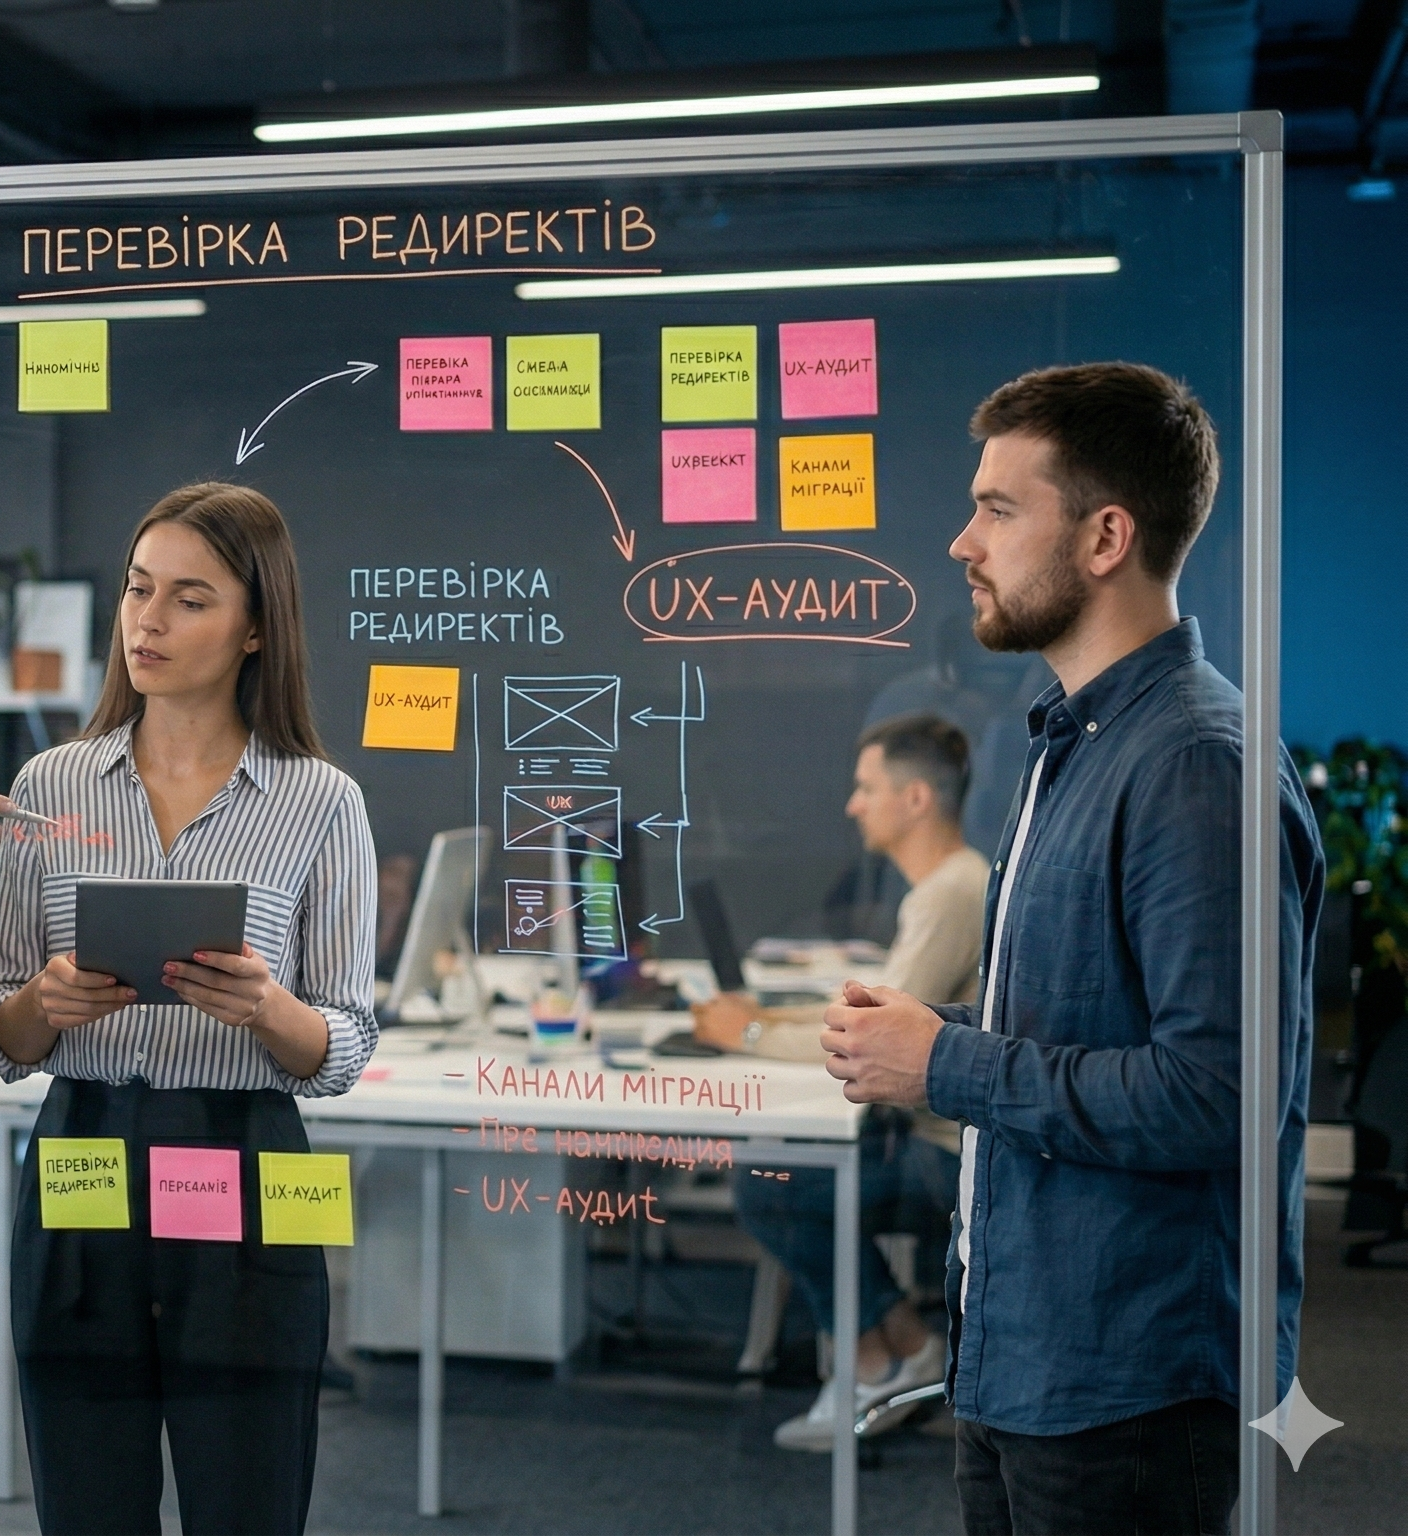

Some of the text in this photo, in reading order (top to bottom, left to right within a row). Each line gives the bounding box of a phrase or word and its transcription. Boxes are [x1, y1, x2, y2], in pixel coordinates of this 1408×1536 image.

[22, 199, 657, 274] ПЕРЕВІРКА РЕДИРЕКТІВ
[669, 349, 743, 364] ПЕРЕВІРКА
[784, 358, 872, 377] UX-АУДИТ
[671, 371, 750, 387] РЕДИРЕКТІВ
[791, 458, 851, 474] КАНАЛИ
[791, 477, 866, 497] МІГРАЦІЇ
[349, 561, 551, 599] ПЕРЕВІРКА
[648, 576, 891, 621] UX-АУДИТ
[349, 606, 565, 645] РЕДИРЕКТІВ
[373, 692, 452, 711] UX-АУДИТ
[264, 1183, 342, 1204] UX-АУДИТ
